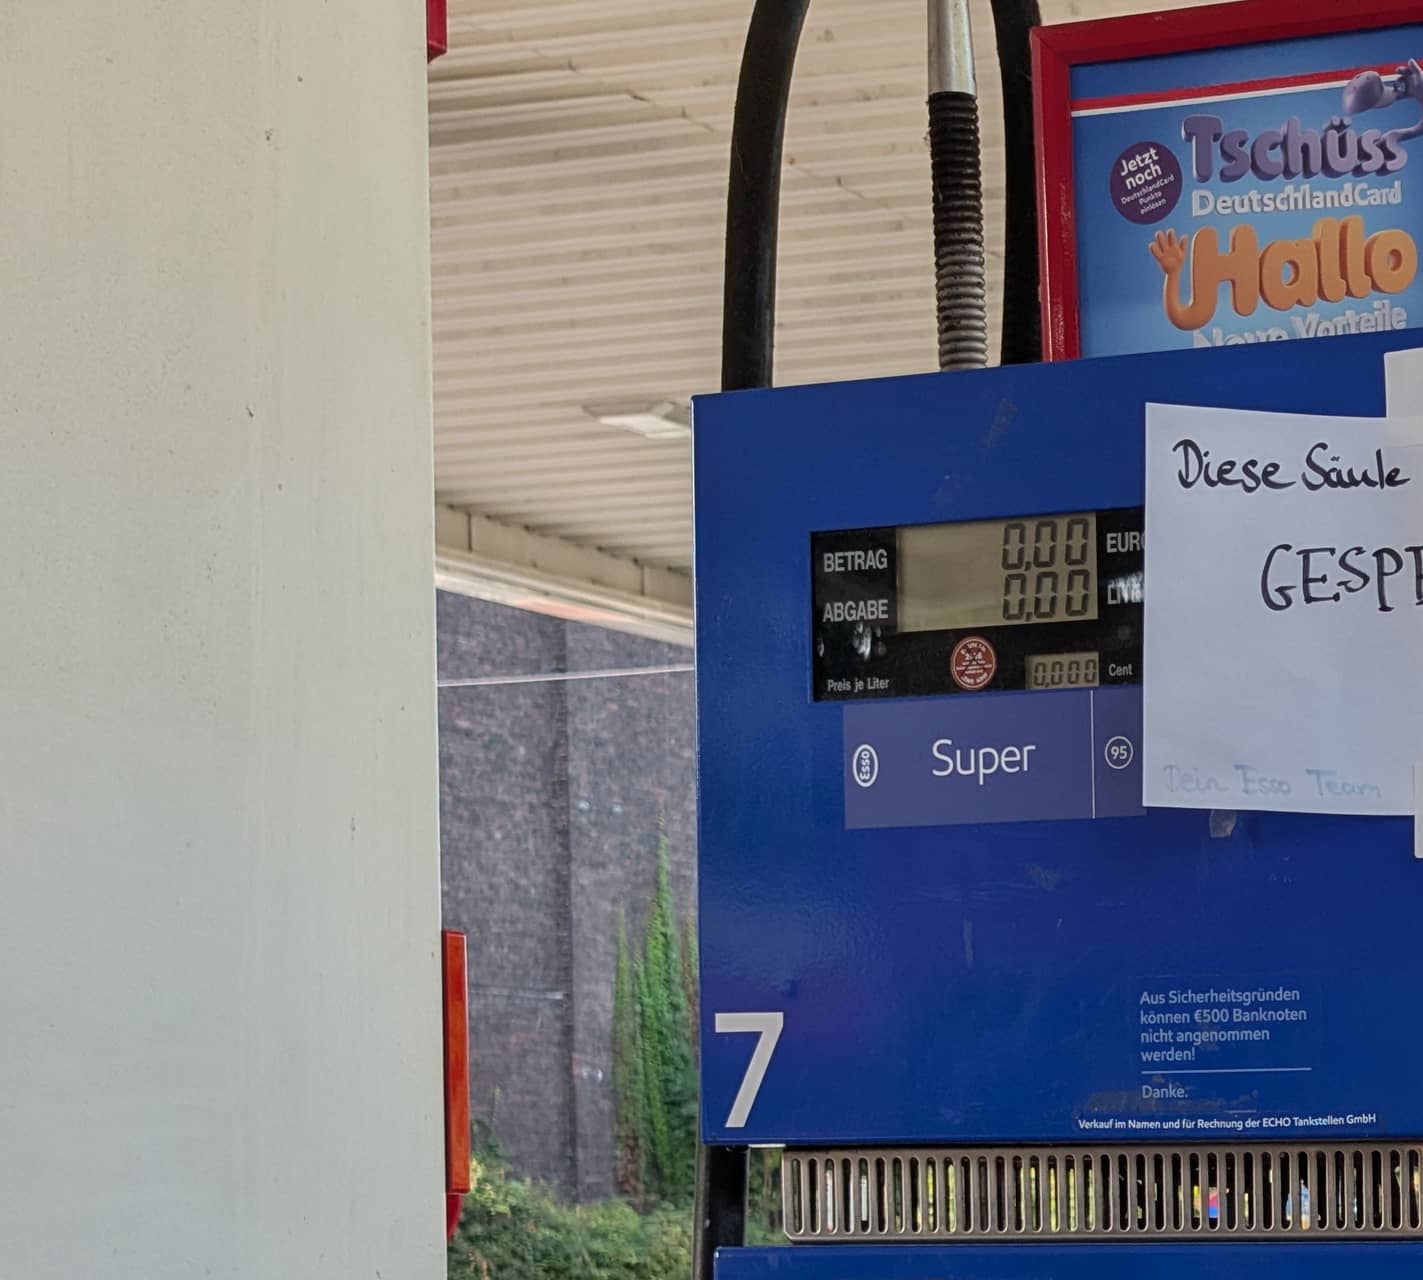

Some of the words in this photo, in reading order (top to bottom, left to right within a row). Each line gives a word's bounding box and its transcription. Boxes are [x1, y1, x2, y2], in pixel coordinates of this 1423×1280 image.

[1120, 147, 1159, 177] Jetzt
[1182, 114, 1408, 183] Tschüss
[1125, 163, 1162, 190] noch
[1191, 180, 1403, 217] DeutschlandCard
[1165, 214, 1418, 331] Hallo
[1291, 300, 1408, 339] Vorteile
[1172, 438, 1297, 493] Diese
[1300, 442, 1411, 493] Säule
[1001, 518, 1090, 571] 0,00
[824, 549, 888, 573] BETRAG
[1001, 569, 1090, 622] 0,00
[823, 599, 889, 623] ABGABE
[827, 678, 851, 692] Preis
[854, 678, 865, 693] je
[867, 676, 889, 690] Liter
[1033, 659, 1097, 688] 0,000
[1108, 663, 1133, 678] Cent
[860, 751, 870, 780] Esso
[932, 738, 1037, 786] Super
[1110, 746, 1128, 760] 95
[1163, 764, 1230, 793] Dein
[1233, 763, 1291, 796] Esso
[1305, 768, 1382, 799] Team
[1140, 991, 1166, 1005] Aus
[1169, 987, 1300, 1006] Sicherheitsgründen
[1140, 1010, 1190, 1026] können
[1194, 1008, 1229, 1024] €500
[1233, 1006, 1307, 1023] Banknoten
[1141, 1029, 1174, 1043] nicht
[1176, 1029, 1270, 1046] angenommen
[715, 1011, 784, 1128] 7
[1141, 1048, 1195, 1062] werden!
[1141, 1083, 1189, 1099] Danke.
[1078, 1118, 1113, 1130] Verkauf
[1115, 1119, 1126, 1130] im
[1128, 1119, 1161, 1130] Namen
[1162, 1118, 1180, 1129] und
[1182, 1118, 1195, 1129] für
[1197, 1117, 1243, 1131] Rechnung
[1245, 1117, 1261, 1128] der
[1262, 1116, 1291, 1128] ECHO
[1292, 1115, 1345, 1127] Tankstellen
[1346, 1113, 1376, 1125] GmbH
